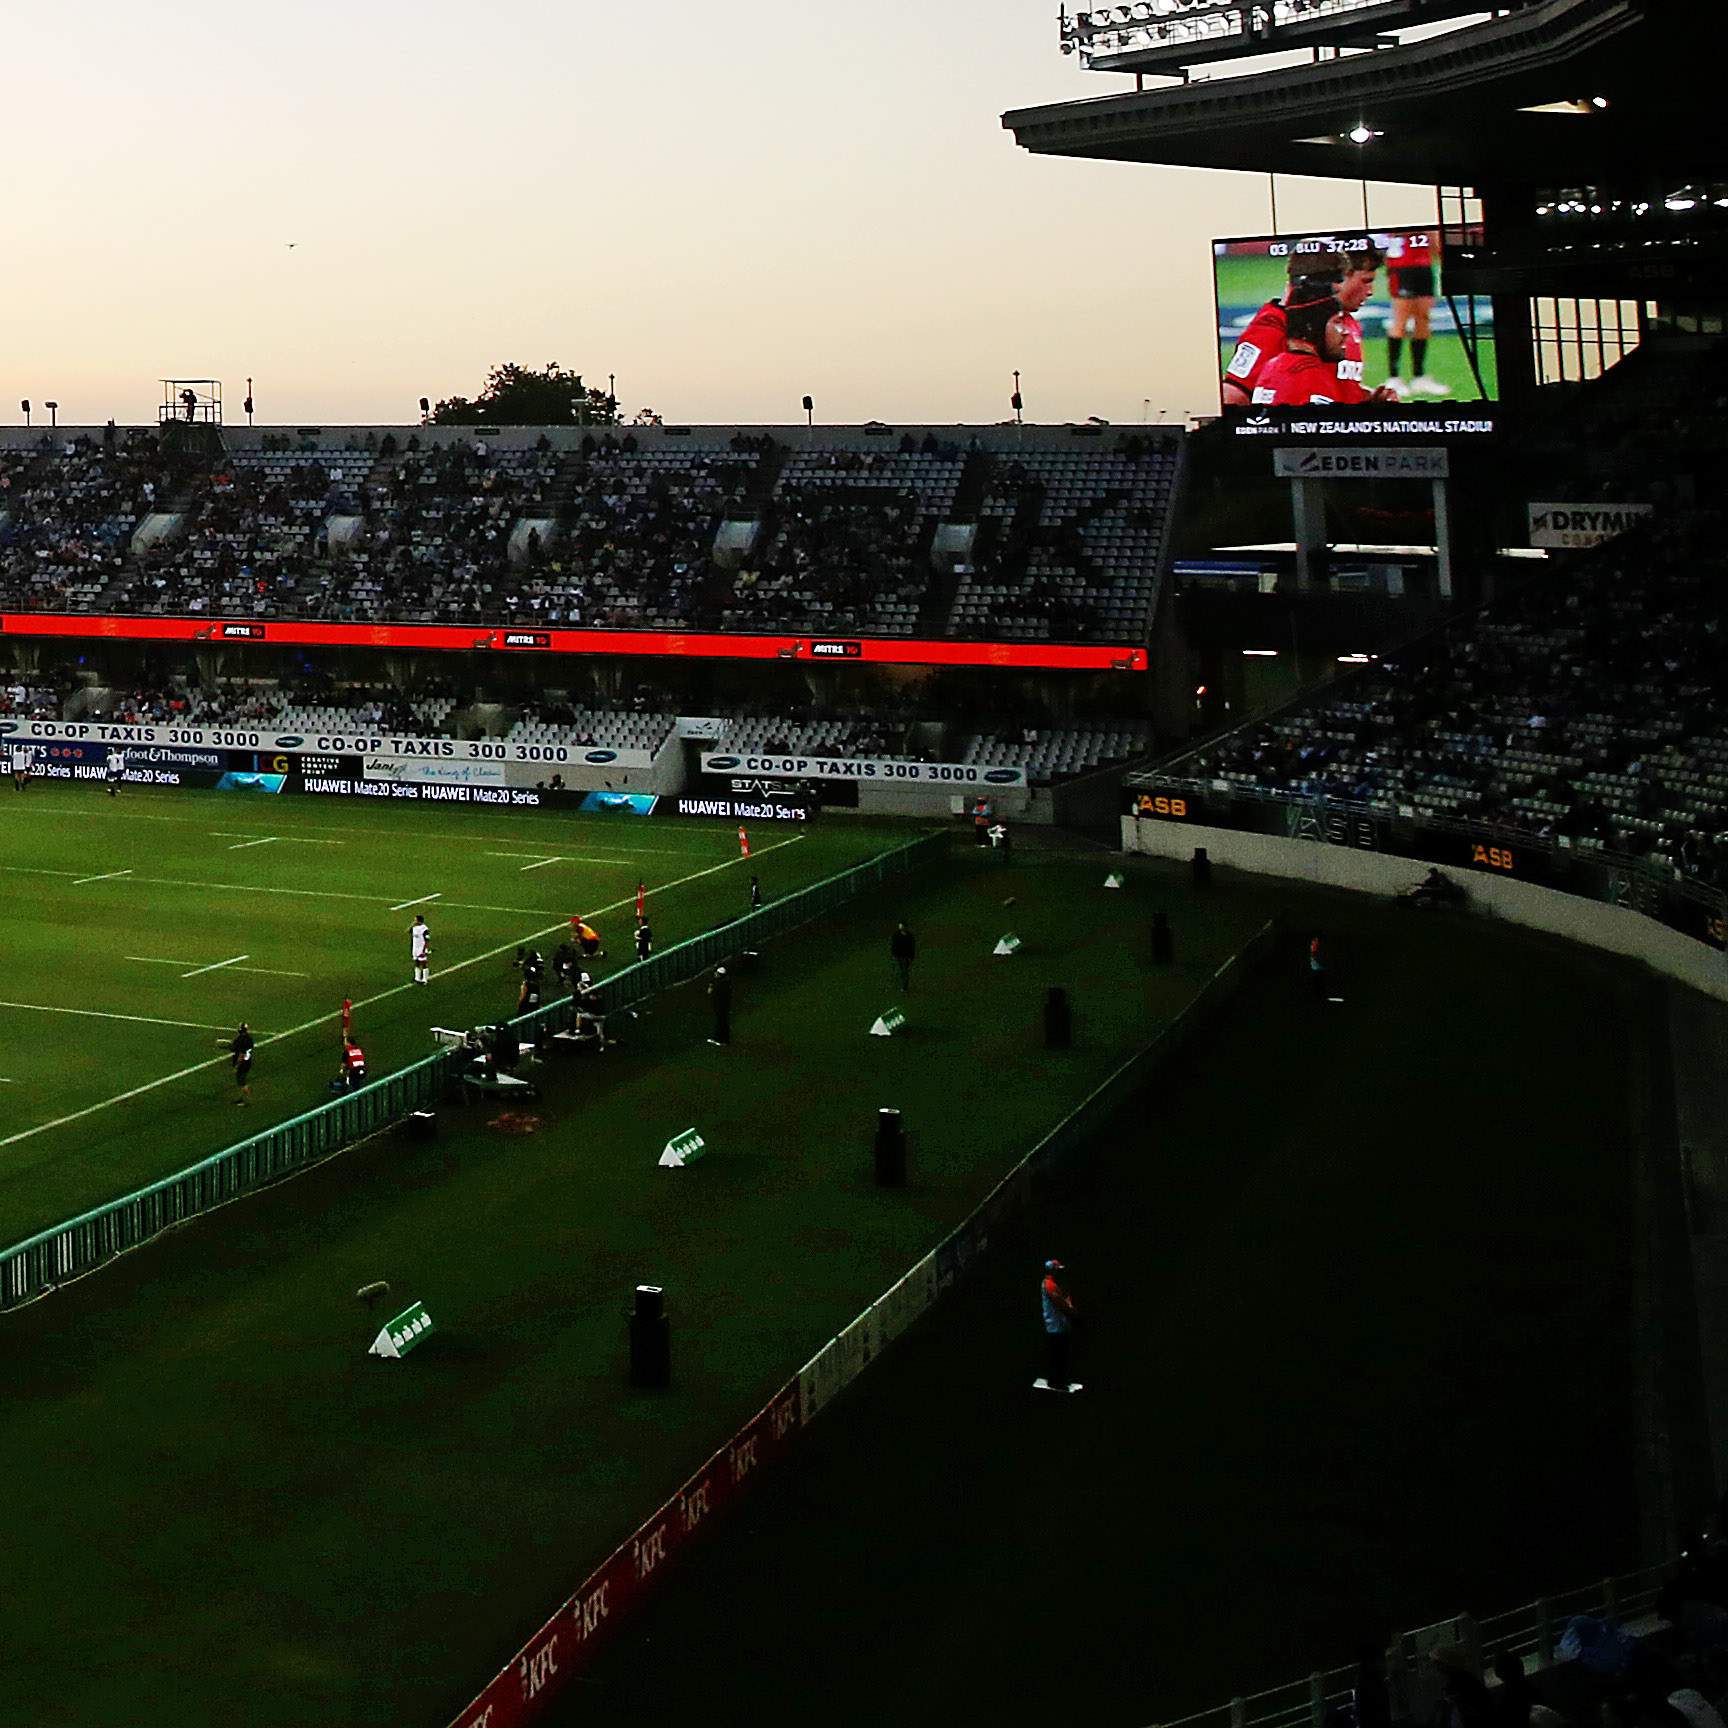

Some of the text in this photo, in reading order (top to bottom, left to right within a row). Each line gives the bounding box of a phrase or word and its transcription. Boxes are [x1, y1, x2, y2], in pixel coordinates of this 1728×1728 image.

[1326, 239, 1368, 252] 37:28
[1409, 235, 1429, 248] 12
[1291, 422, 1317, 433] NEW
[1319, 422, 1382, 433] ZEALAND'S
[1383, 421, 1444, 433] NATIONAL
[1321, 456, 1444, 471] EDEN PARK
[814, 645, 843, 654] MITRE
[31, 723, 259, 746] CO-OP TAXIS 300 3000
[318, 737, 568, 762] CO-OP TAXIS 300 3000
[47, 764, 70, 777] Series
[75, 766, 107, 778] HUAW
[156, 771, 180, 785] Series
[747, 757, 977, 782] CO-OP TAXIS 300 3000
[305, 779, 418, 798] HUAWEI Mate20 Series
[422, 785, 539, 806] HUAWEI Mate20 Series
[679, 800, 730, 815] HUAWEI
[734, 802, 773, 818] Mate20
[1137, 795, 1187, 816] ASB
[1472, 844, 1514, 871] ASB
[640, 1524, 666, 1578] KFC
[583, 1580, 609, 1639] KFC
[529, 1634, 558, 1700] KFC
